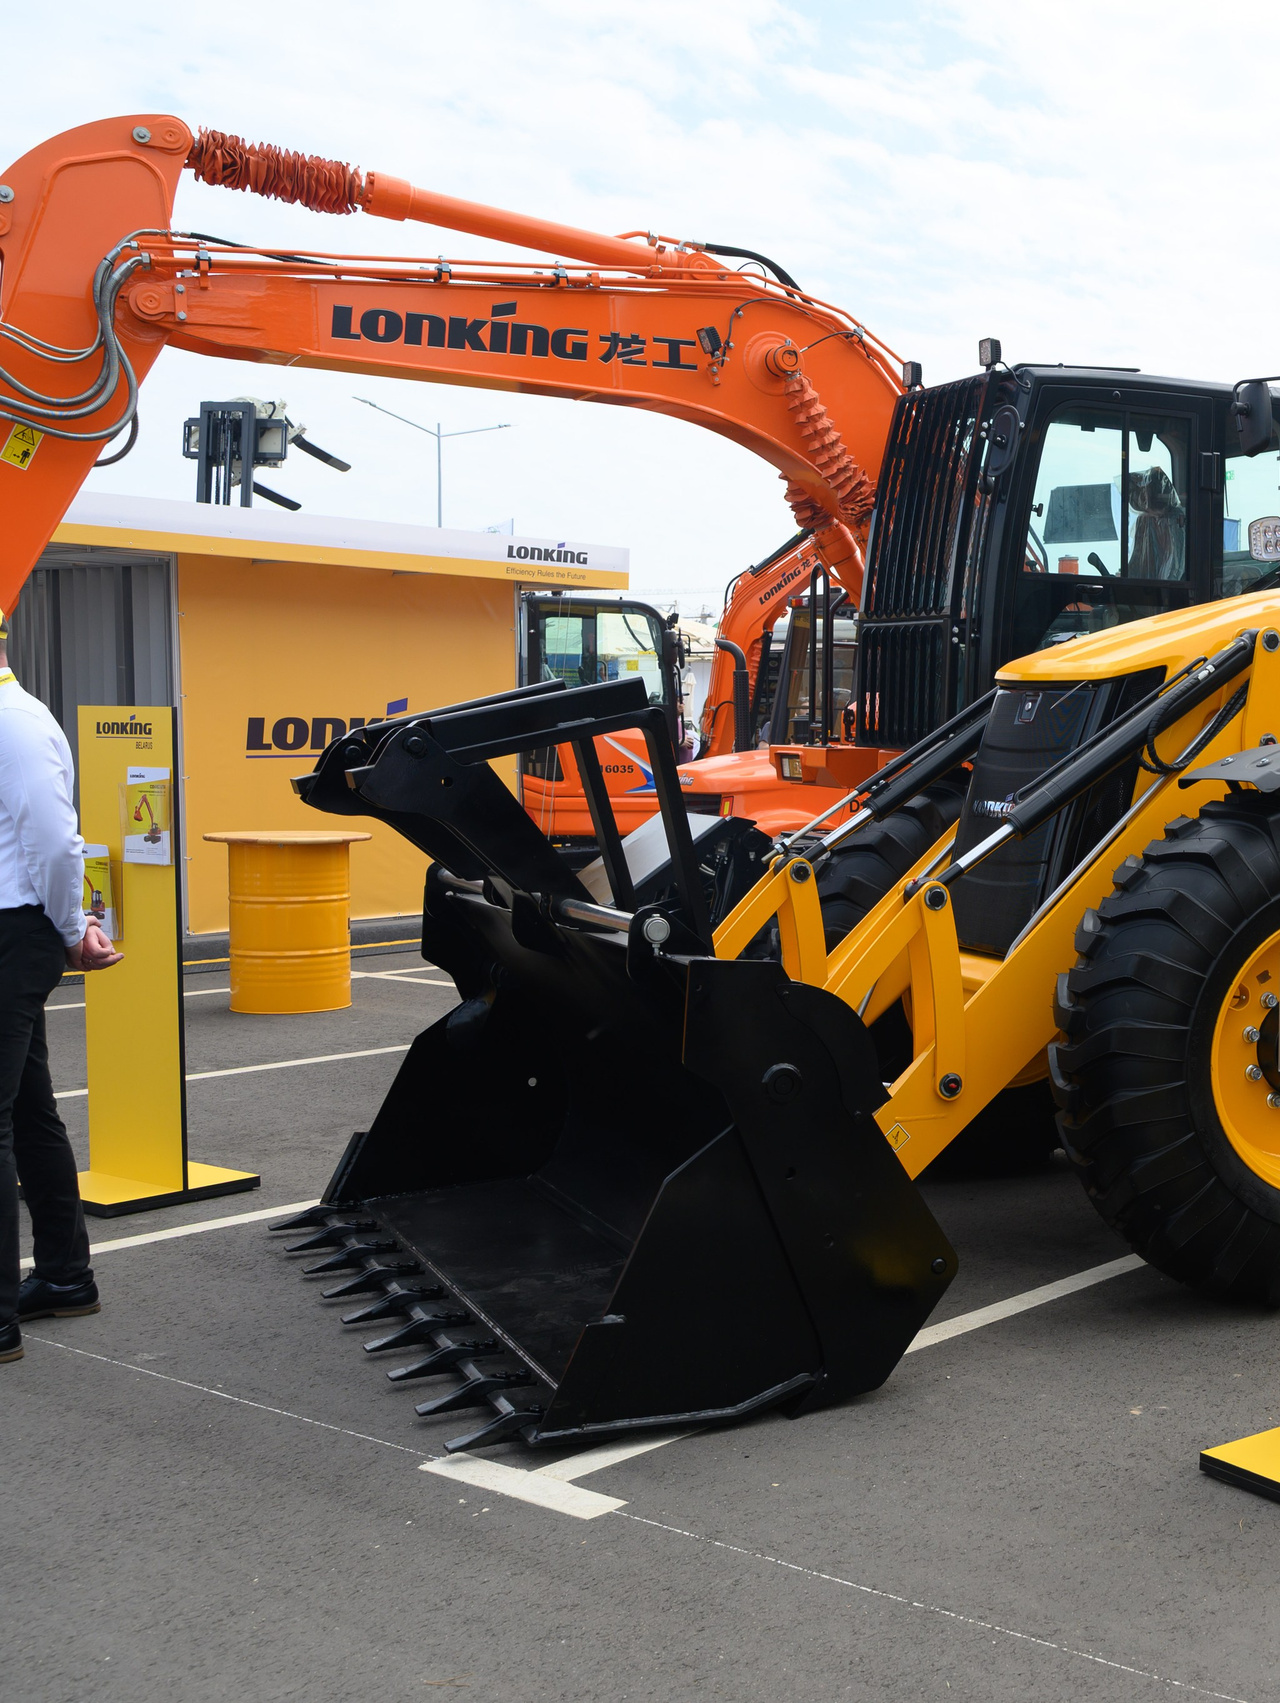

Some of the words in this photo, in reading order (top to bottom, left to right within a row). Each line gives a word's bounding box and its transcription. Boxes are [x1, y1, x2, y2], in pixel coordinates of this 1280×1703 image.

[331, 301, 589, 361] LONKING
[598, 331, 698, 371] 龙工
[507, 542, 588, 565] LONKING
[506, 567, 536, 577] Efficiency
[537, 570, 554, 578] Rules
[567, 572, 586, 580] Future
[96, 714, 152, 736] LONKING
[135, 741, 153, 750] BELARUS
